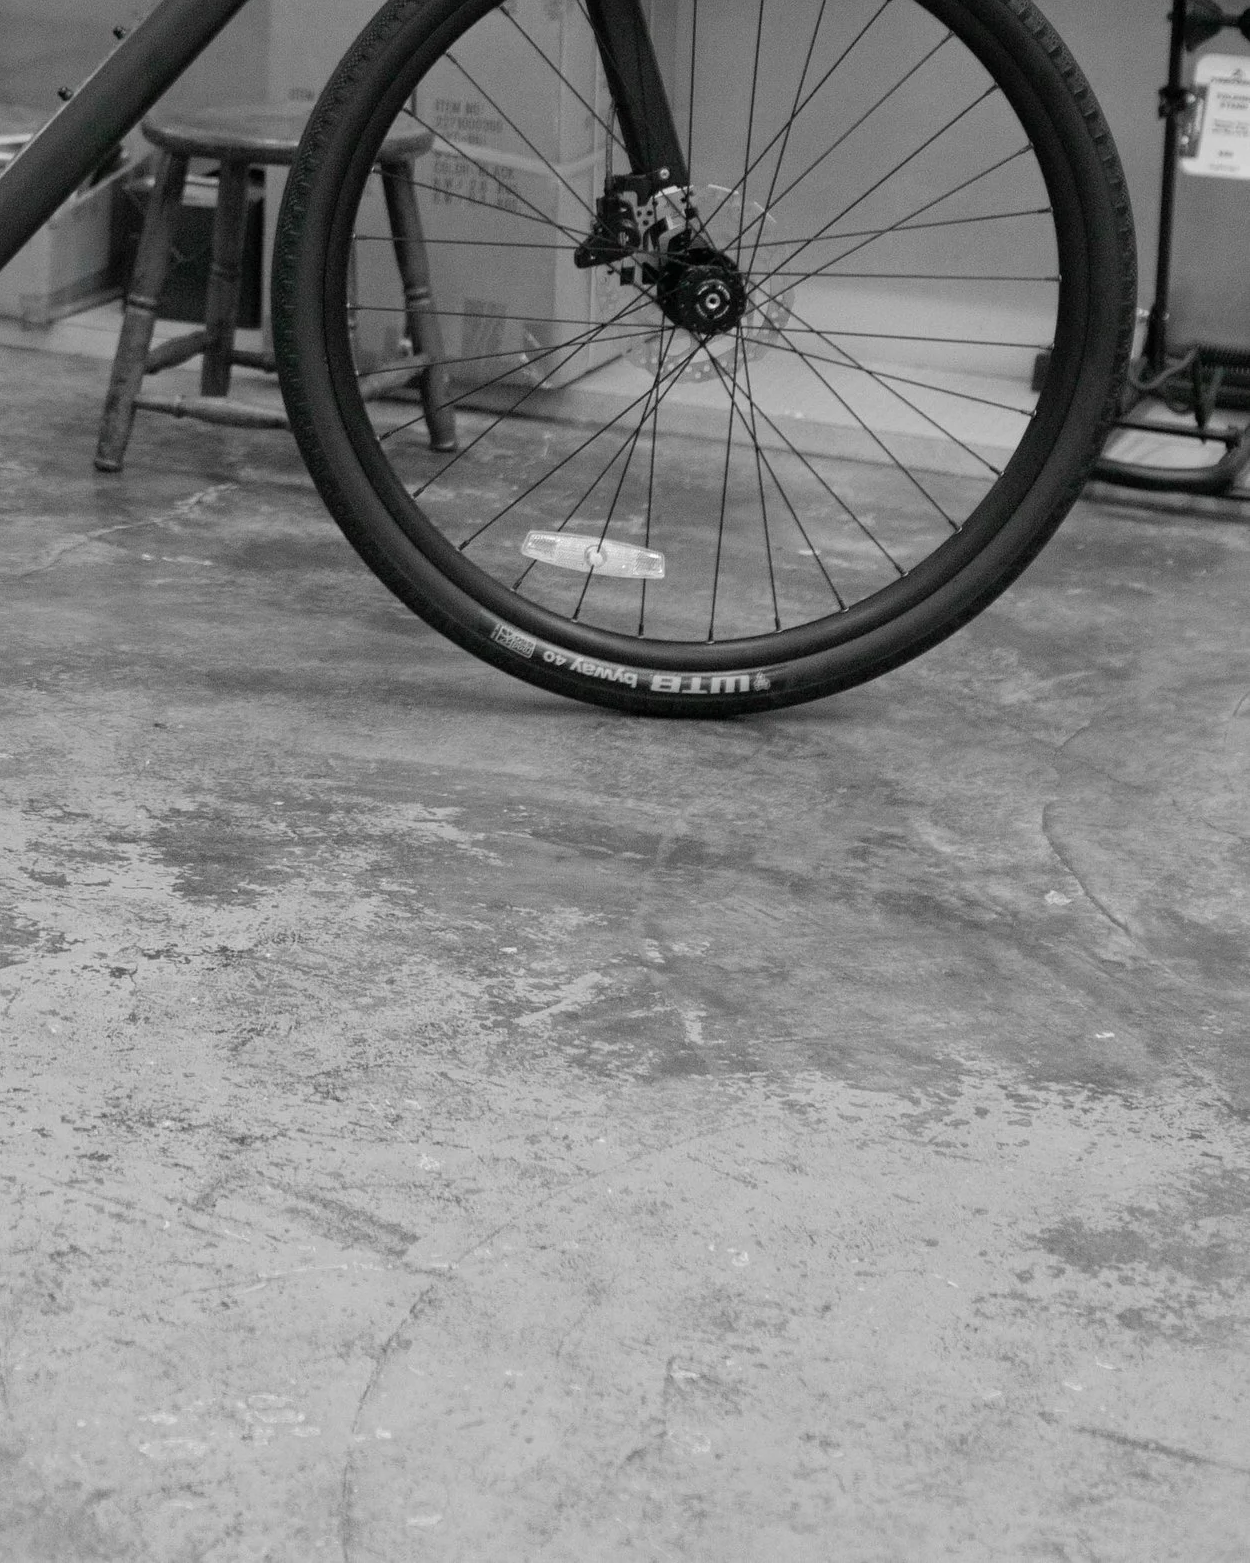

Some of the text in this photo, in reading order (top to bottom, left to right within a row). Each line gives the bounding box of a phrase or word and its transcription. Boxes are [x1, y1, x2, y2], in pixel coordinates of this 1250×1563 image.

[541, 649, 751, 695] WTB byway 40
